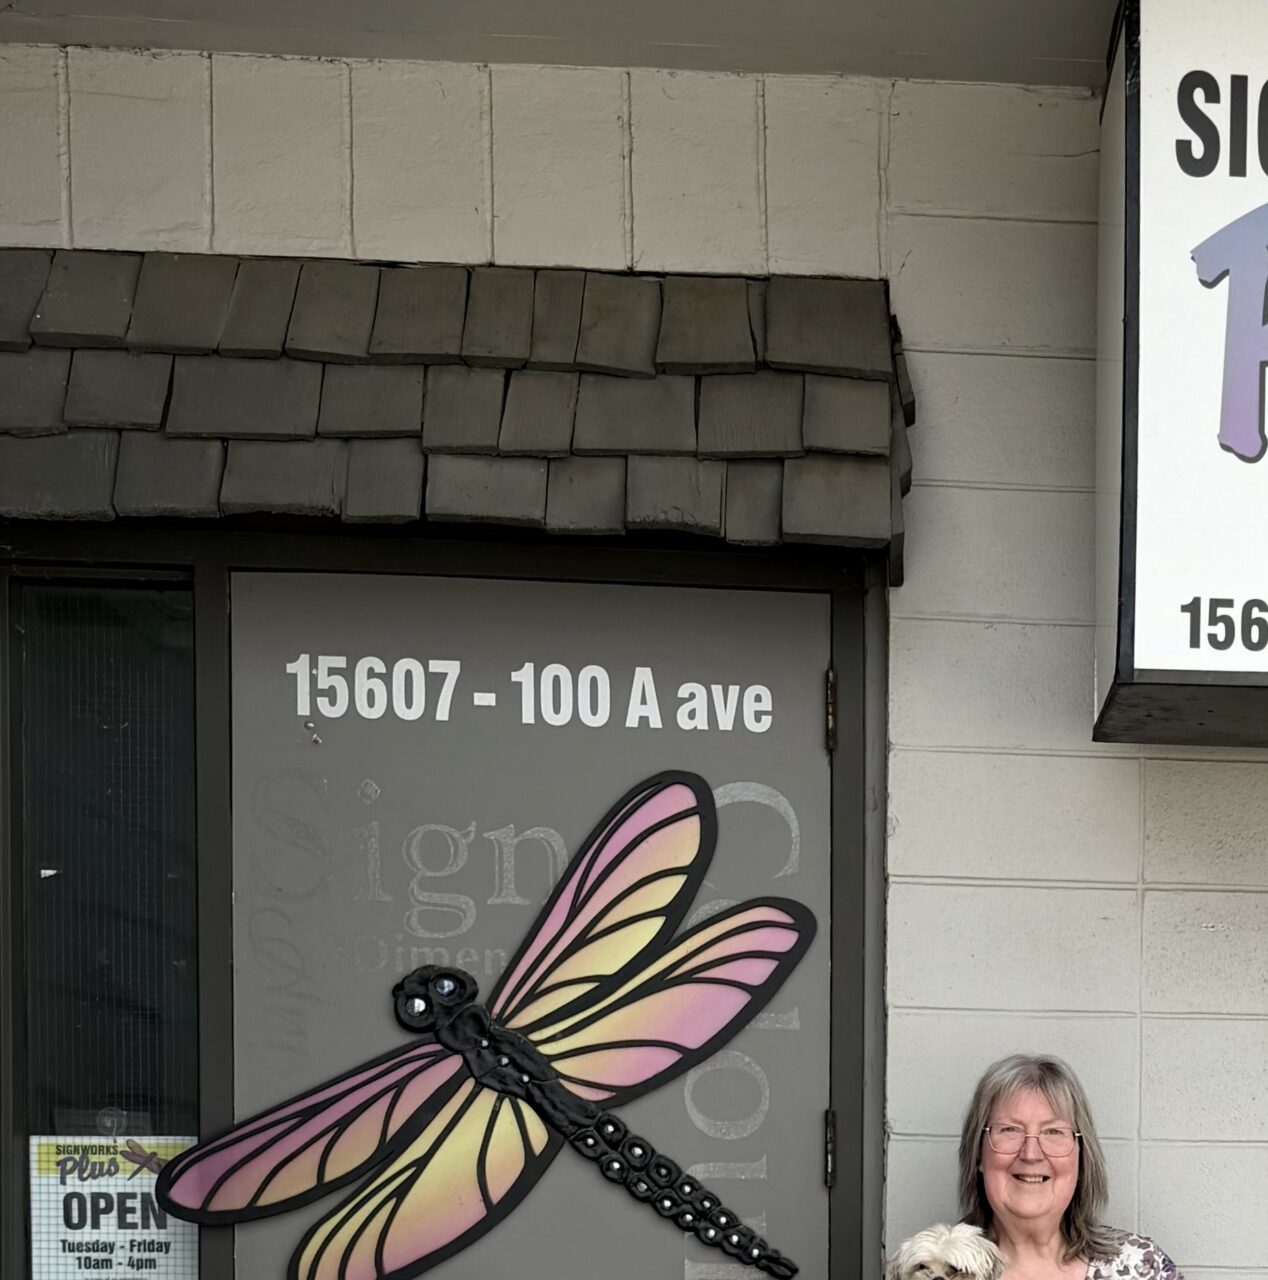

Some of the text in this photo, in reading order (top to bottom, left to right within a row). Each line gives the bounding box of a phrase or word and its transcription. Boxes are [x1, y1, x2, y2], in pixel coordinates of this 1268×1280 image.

[286, 653, 461, 721] 15607
[510, 662, 610, 727] 100
[625, 667, 663, 729] A
[676, 682, 773, 733] ave
[56, 1145, 118, 1155] SIGNWORKS
[56, 1156, 119, 1185] Plus
[62, 1192, 167, 1230] OPEN
[61, 1239, 115, 1254] Tuesday
[130, 1239, 171, 1254] Friday
[76, 1256, 113, 1269] 10am
[127, 1257, 157, 1270] 4pm
